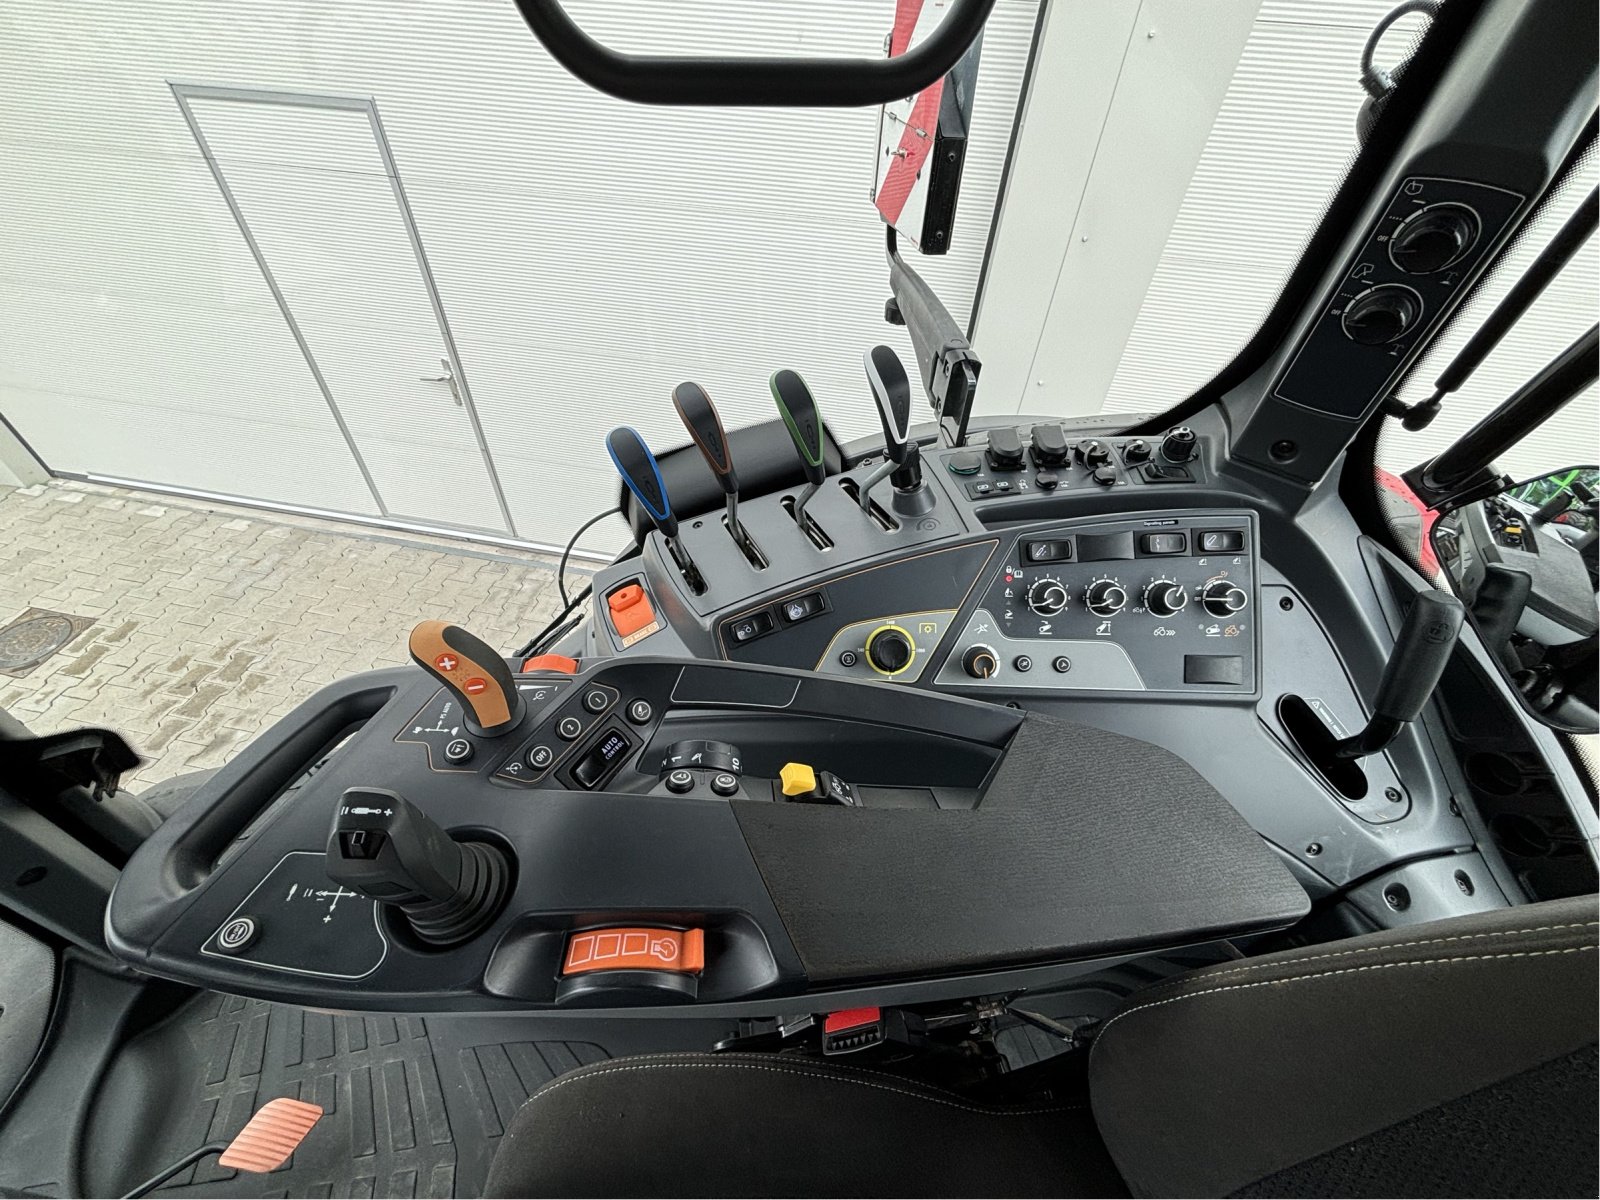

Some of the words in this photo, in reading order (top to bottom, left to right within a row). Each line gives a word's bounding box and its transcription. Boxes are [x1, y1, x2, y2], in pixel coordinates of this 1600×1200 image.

[1376, 234, 1390, 242] OFF
[442, 702, 452, 713] AUTO
[601, 736, 618, 755] AUTO
[604, 740, 625, 760] CONTROL
[535, 750, 548, 762] OFF
[732, 757, 740, 771] 10
